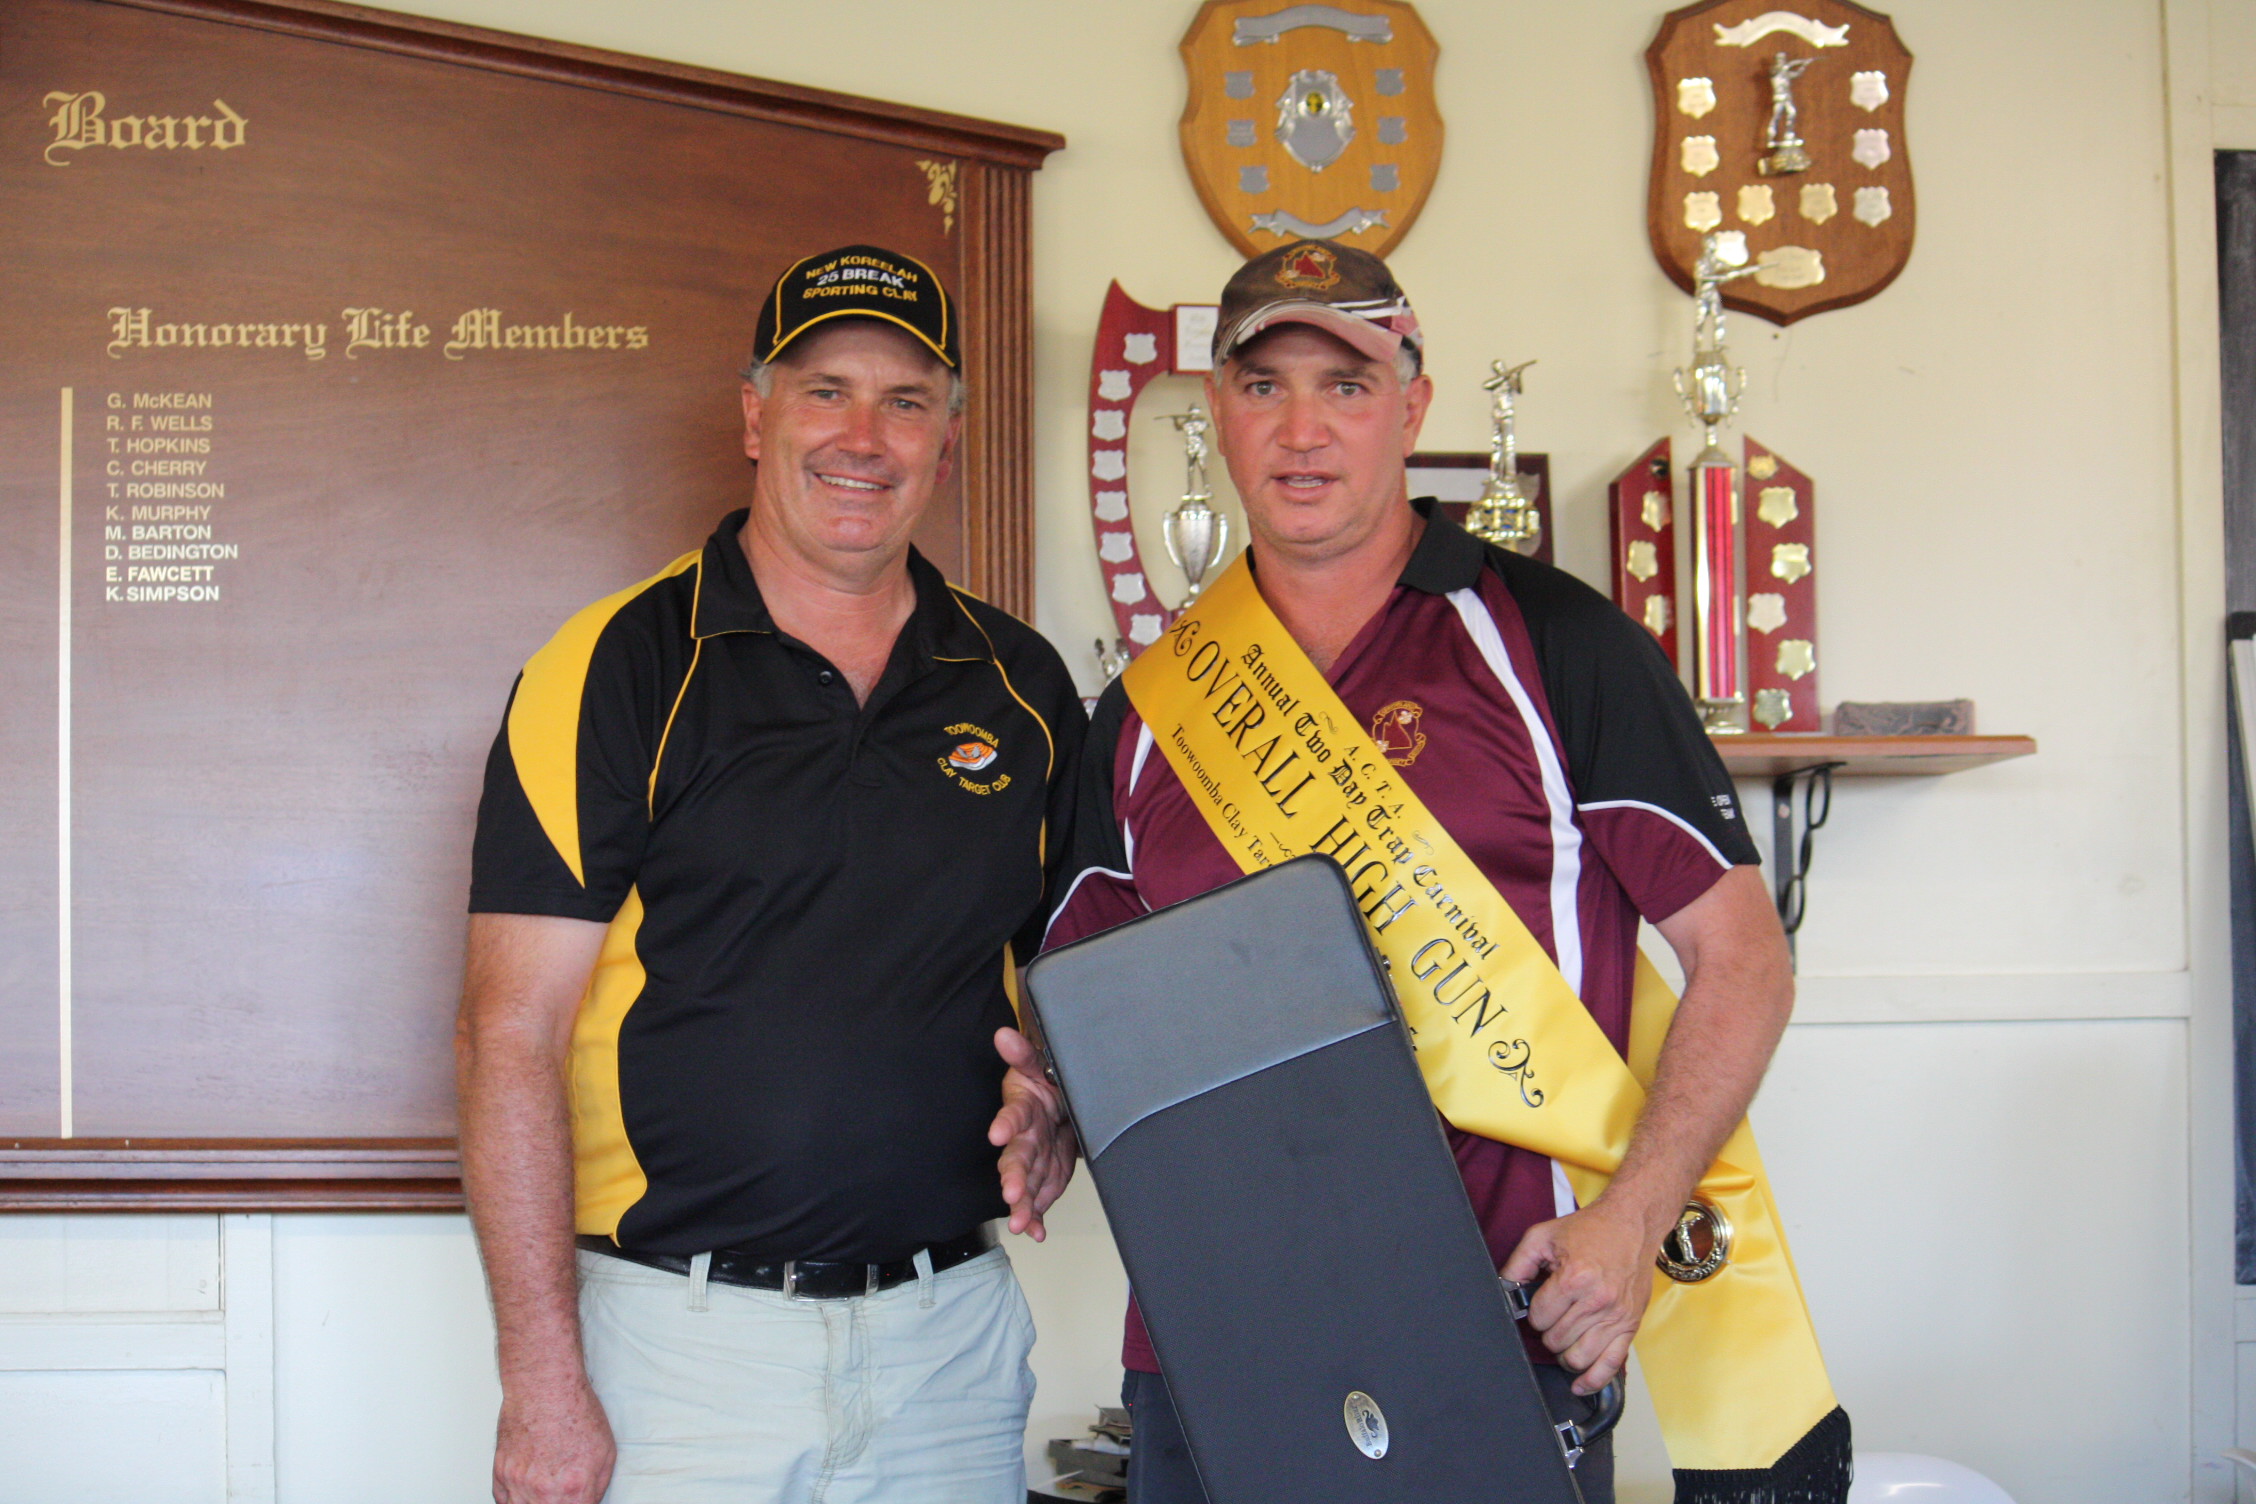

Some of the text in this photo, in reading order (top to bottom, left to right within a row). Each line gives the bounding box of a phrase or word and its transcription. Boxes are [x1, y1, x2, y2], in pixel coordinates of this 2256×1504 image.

[43, 91, 249, 167] Board
[805, 260, 838, 280] NEW
[816, 268, 905, 289] 25 BREAK
[802, 284, 878, 300] SPORTING
[106, 307, 648, 360] Honorary Life Members
[107, 393, 212, 409] G. McKEAN
[106, 415, 213, 431] R. F. WELLS
[107, 438, 211, 453] T. HOPKINS
[106, 460, 207, 476] C. CHERRY
[107, 483, 225, 498] T. ROBINSON
[105, 505, 211, 521] K. MURPHY
[105, 525, 211, 541] M. BARTON
[105, 544, 238, 560] D. BEDINGTON
[106, 565, 214, 582] E. FAWCETT
[106, 585, 219, 601] K. SIMPSON
[937, 758, 957, 778] CLAY
[958, 776, 992, 795] TARGET
[1170, 723, 1274, 868] Toowoomba Clay Tar
[1241, 643, 1301, 717] Annual
[1294, 712, 1332, 764] Two
[1328, 757, 1368, 810] Day
[1366, 804, 1415, 865] Trap
[1412, 864, 1501, 961] Carnival
[1186, 640, 1317, 820] OVERALL
[1308, 813, 1419, 937] HIGH
[1410, 937, 1509, 1039] GUN
